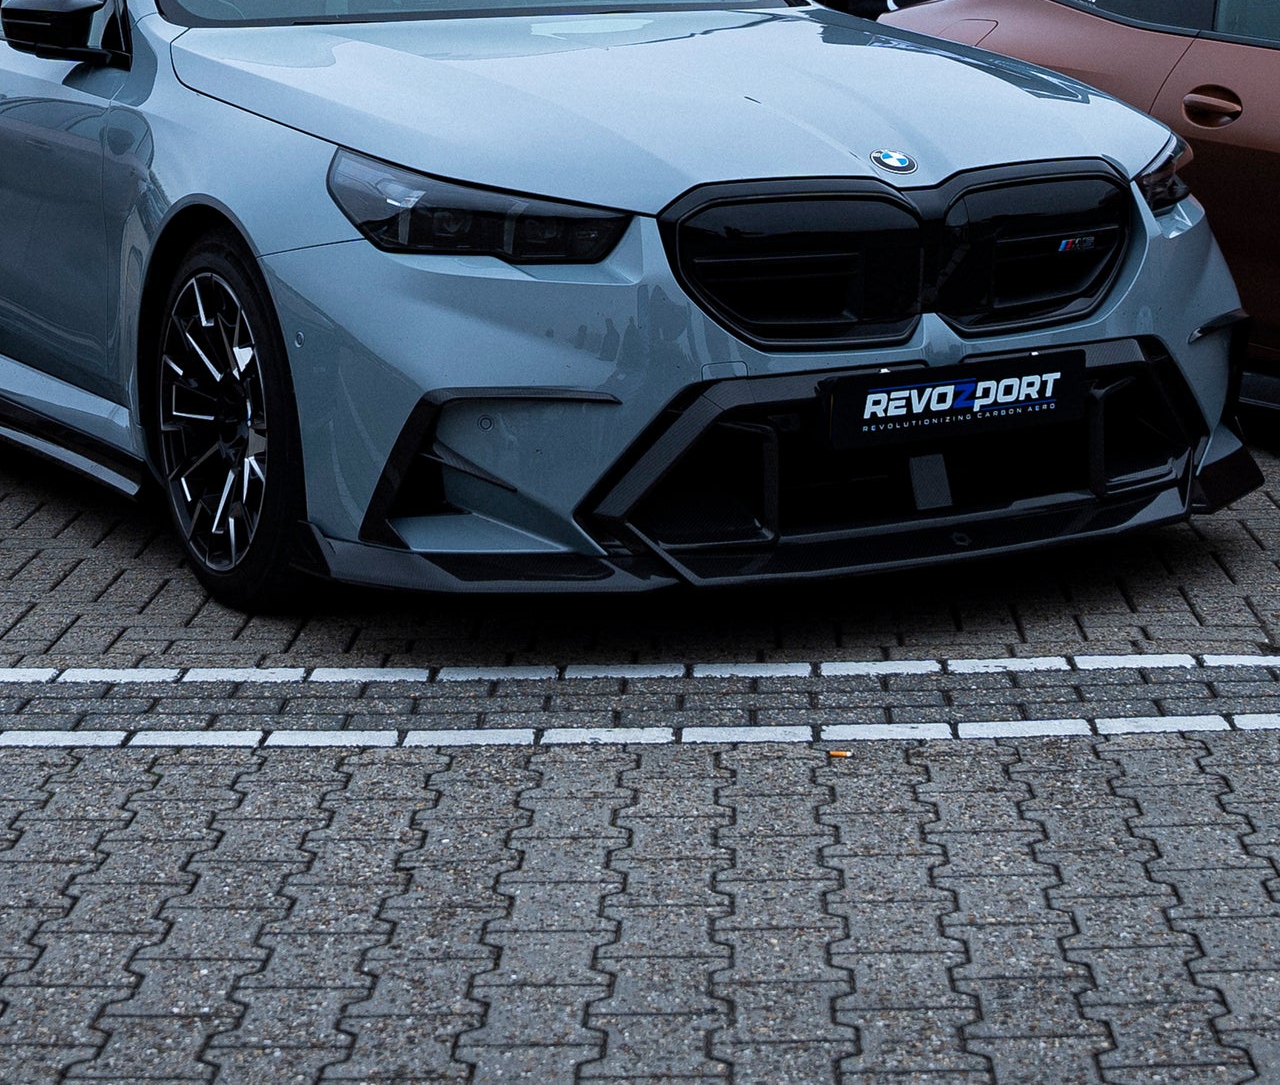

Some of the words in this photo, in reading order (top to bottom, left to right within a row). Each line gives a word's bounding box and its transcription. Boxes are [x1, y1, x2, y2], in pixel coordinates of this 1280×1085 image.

[863, 372, 1061, 420] REVOZPORT
[862, 413, 971, 433] REVOLUTIONIZING
[976, 407, 1022, 419] CARBON
[1027, 402, 1056, 413] AERO
